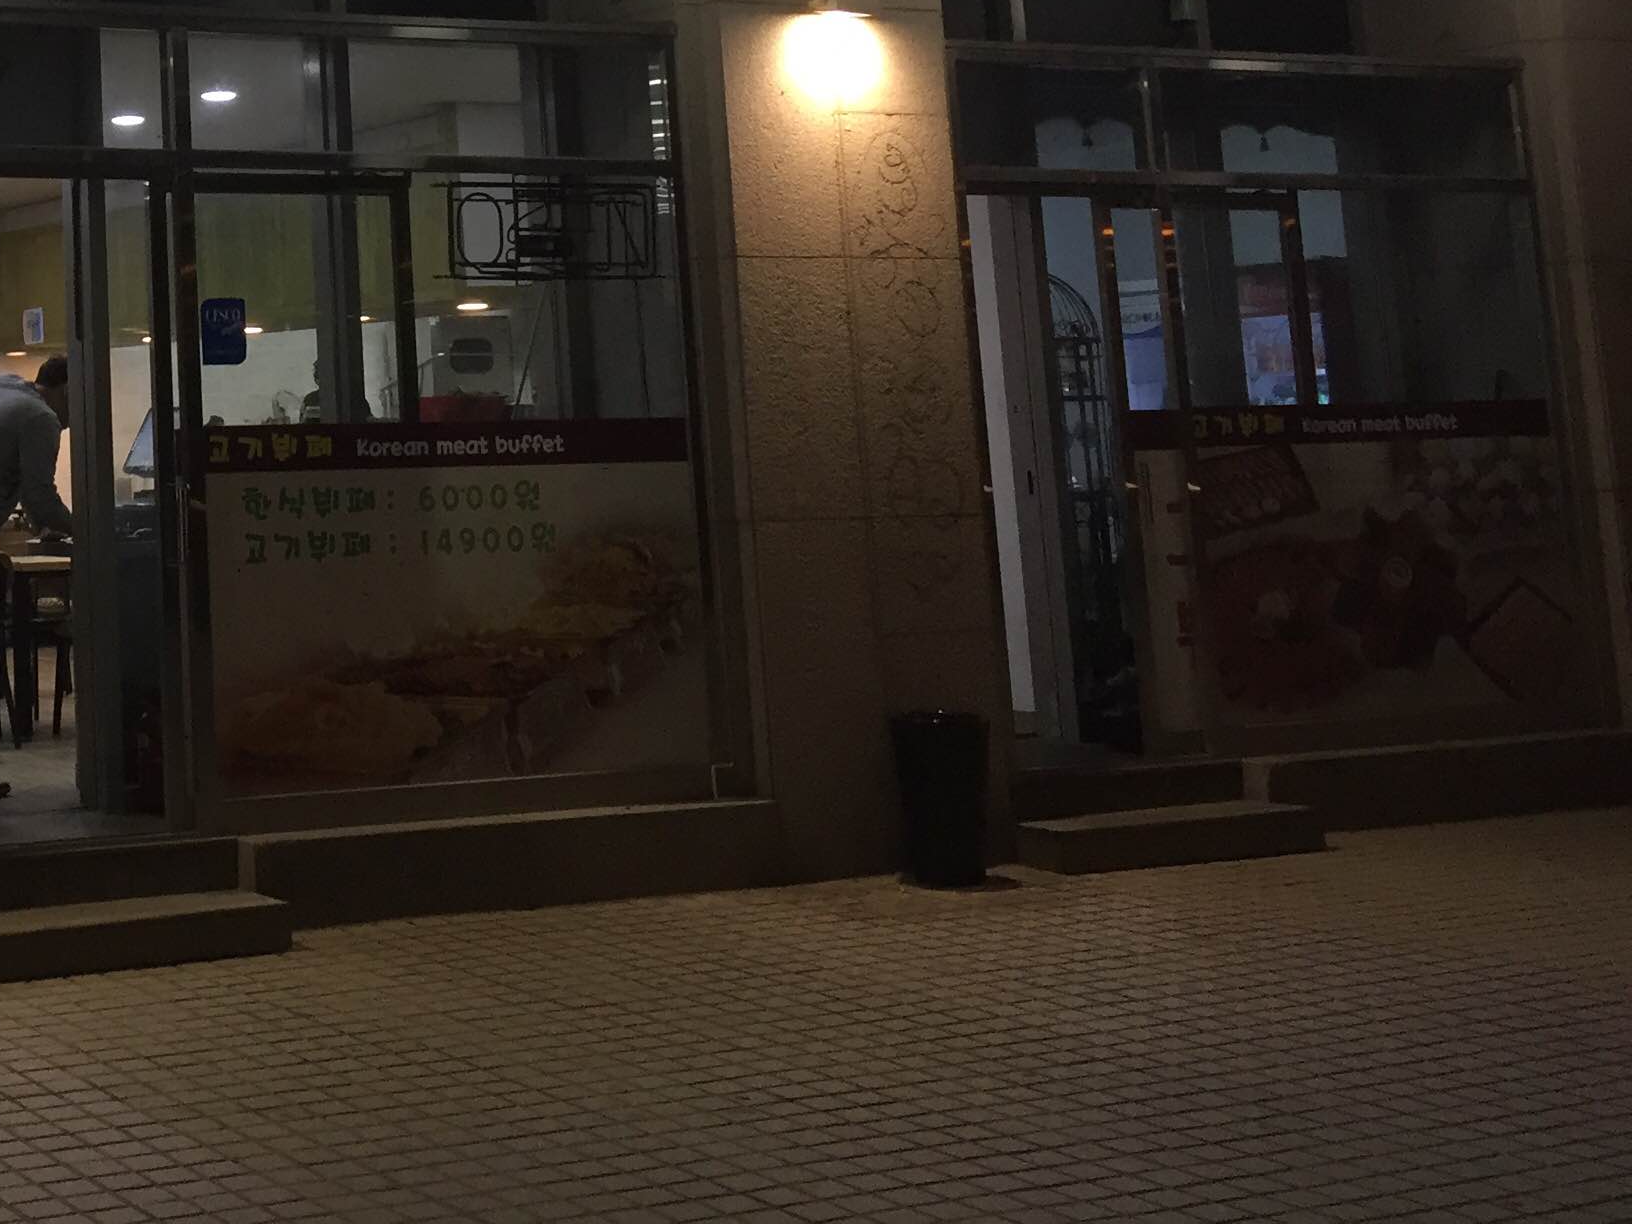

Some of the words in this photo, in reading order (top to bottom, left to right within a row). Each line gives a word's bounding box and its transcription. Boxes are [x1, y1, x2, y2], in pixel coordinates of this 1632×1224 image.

[1405, 413, 1459, 432] buffet
[356, 437, 430, 458] Korean
[436, 436, 488, 456] meat
[495, 434, 565, 455] buffet
